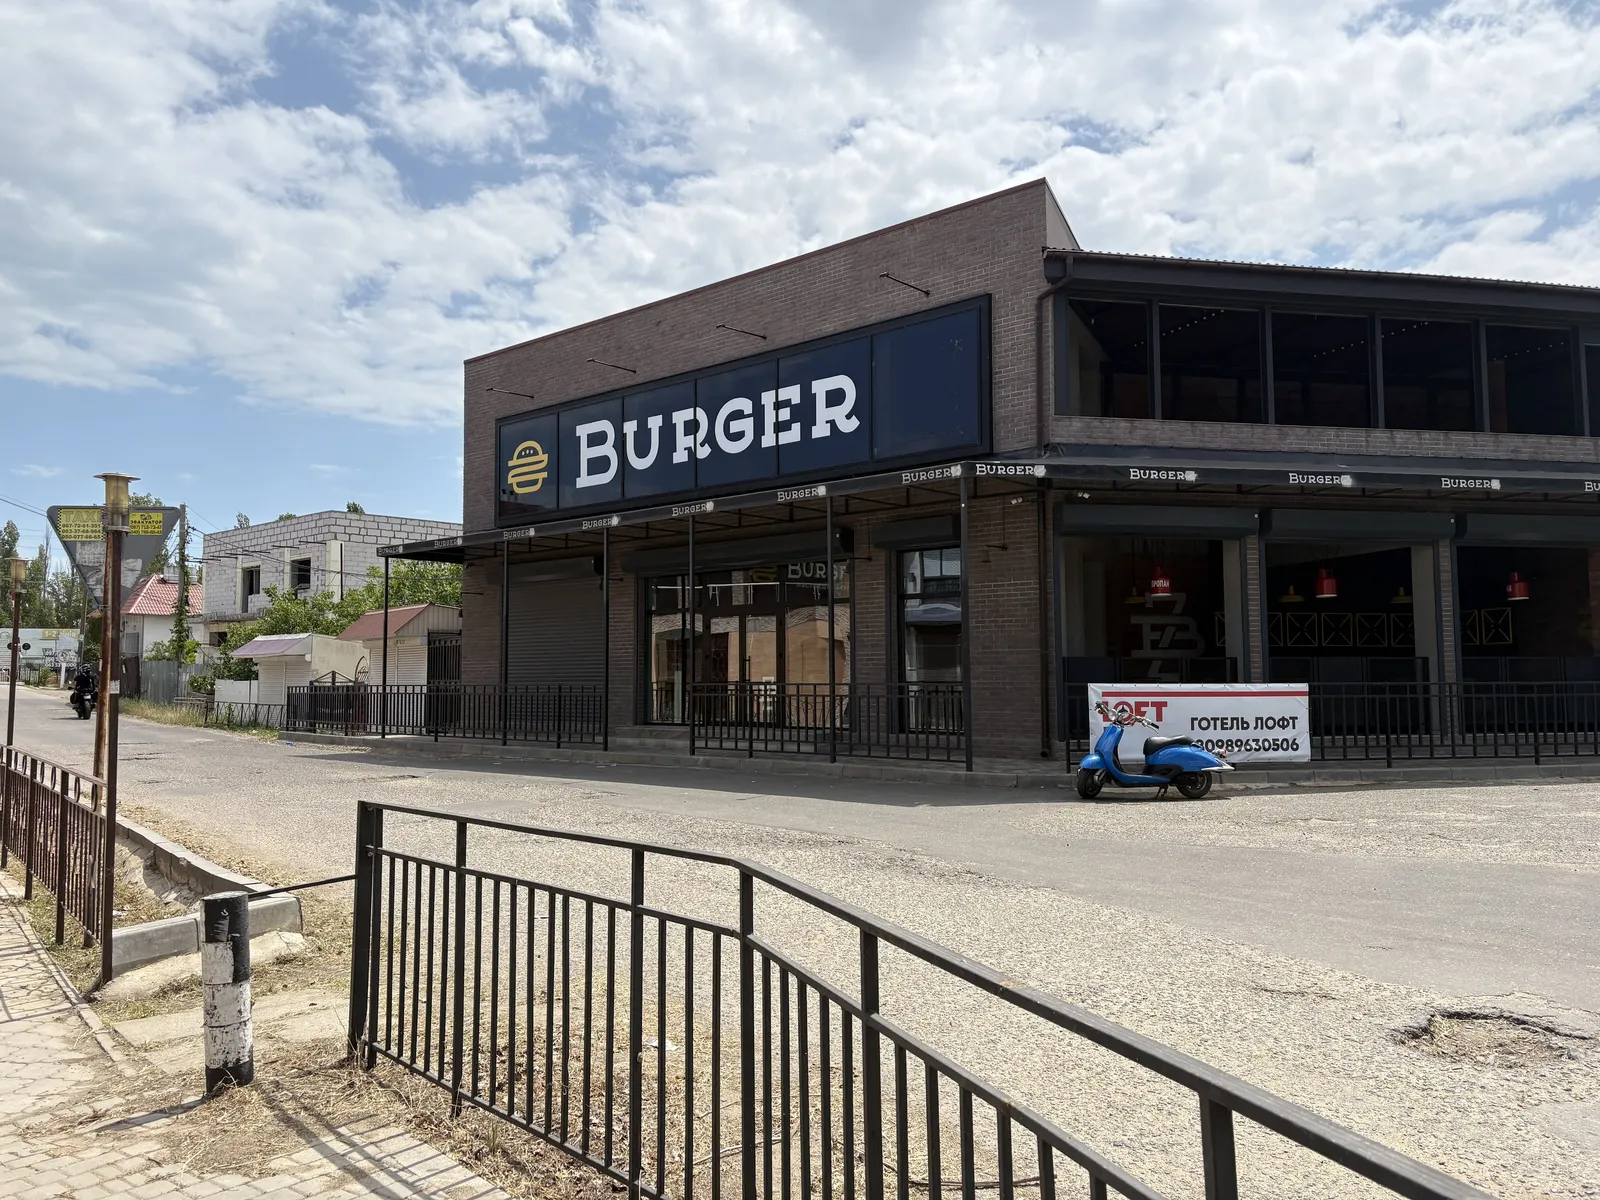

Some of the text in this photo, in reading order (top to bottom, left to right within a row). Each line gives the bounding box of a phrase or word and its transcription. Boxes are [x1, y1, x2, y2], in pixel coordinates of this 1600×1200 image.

[575, 374, 861, 489] BURGER
[902, 467, 951, 484] BURGER
[976, 463, 1035, 476] BURGER
[1130, 468, 1186, 481] BURGER
[1288, 473, 1340, 485] BURGER
[1441, 477, 1491, 489] BURGER
[777, 487, 818, 501] BURGER
[671, 503, 707, 517] BURGER
[582, 518, 613, 530] BURGER
[503, 528, 530, 540] BURGER
[434, 539, 458, 549] BURGER
[1191, 715, 1298, 731] ГОТЕЛЬ ЛОФТ
